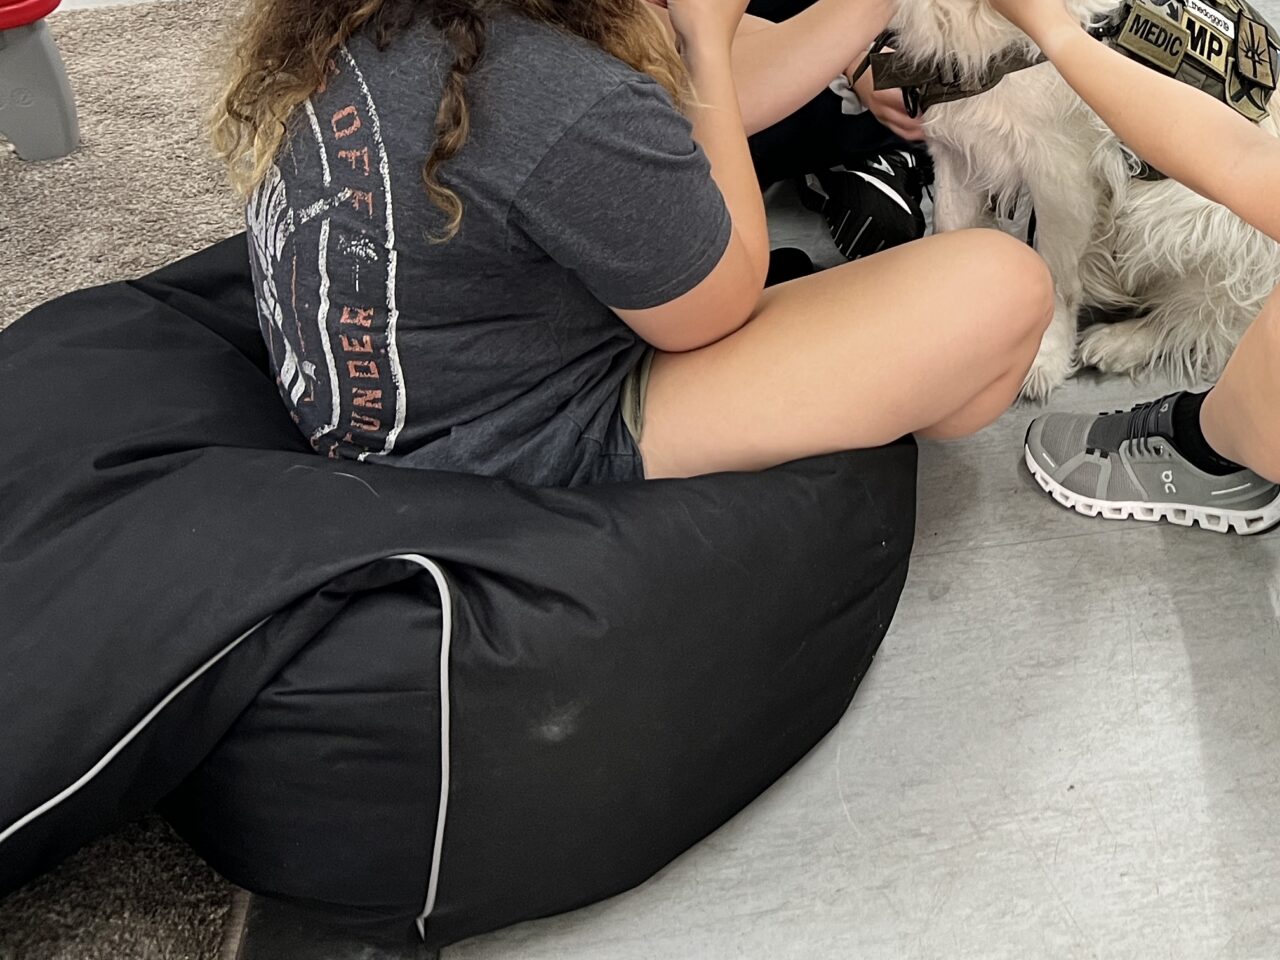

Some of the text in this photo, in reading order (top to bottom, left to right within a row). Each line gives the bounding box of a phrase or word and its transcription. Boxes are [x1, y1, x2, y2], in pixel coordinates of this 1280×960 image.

[1128, 13, 1183, 57] MEDIC
[1186, 16, 1224, 61] MP
[328, 305, 383, 458] UNDER
